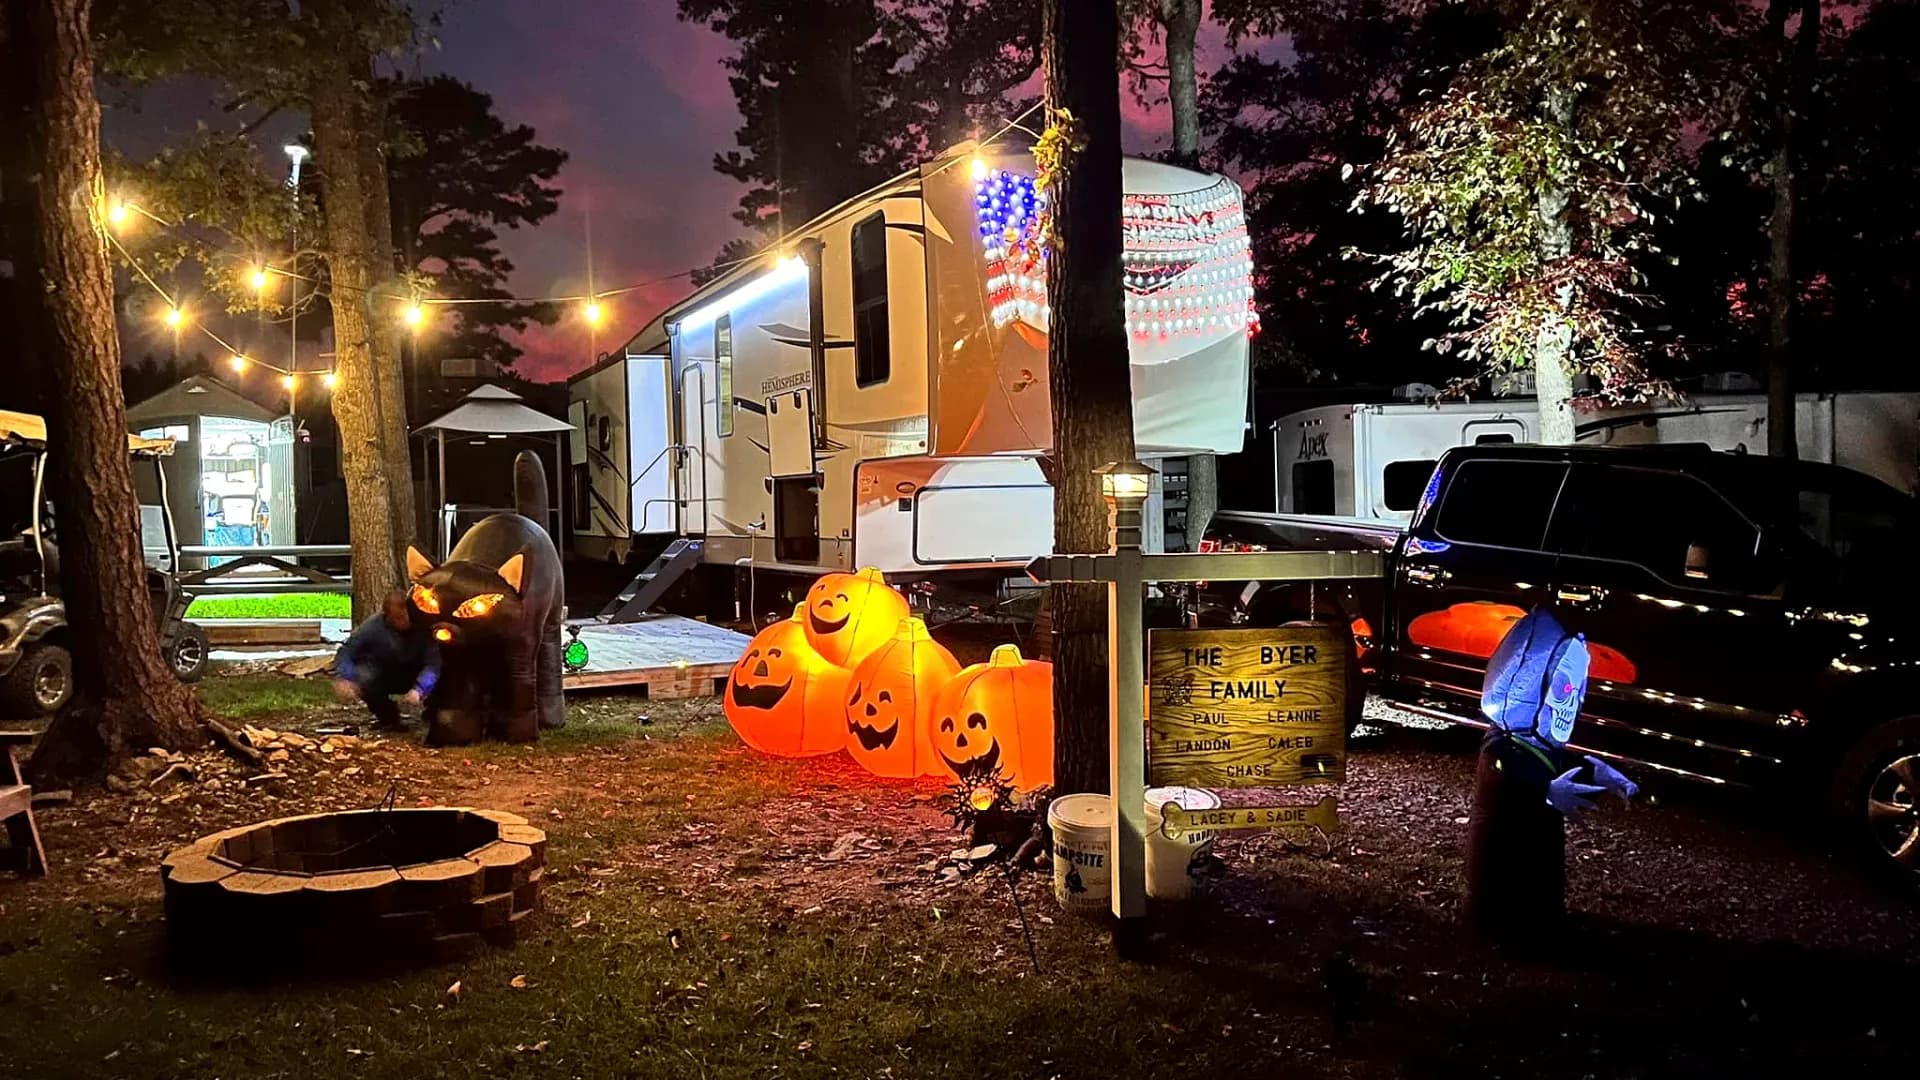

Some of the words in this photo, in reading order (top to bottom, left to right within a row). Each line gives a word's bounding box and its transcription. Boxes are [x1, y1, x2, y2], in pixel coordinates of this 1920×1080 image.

[761, 370, 811, 394] HEMISPHERE
[1182, 647, 1222, 667] THE
[1260, 645, 1318, 665] BYER
[1210, 679, 1287, 700] FAMILY
[1193, 712, 1229, 726] PAUL
[1267, 710, 1322, 723] LEANNE
[1176, 739, 1231, 753] LANDON
[1268, 737, 1313, 751] CALEB
[1226, 765, 1271, 778] CHASE
[1191, 812, 1236, 826] LACEY
[1247, 810, 1257, 823] &
[1267, 809, 1306, 823] SADIE
[1053, 841, 1104, 868] AMPSITE
